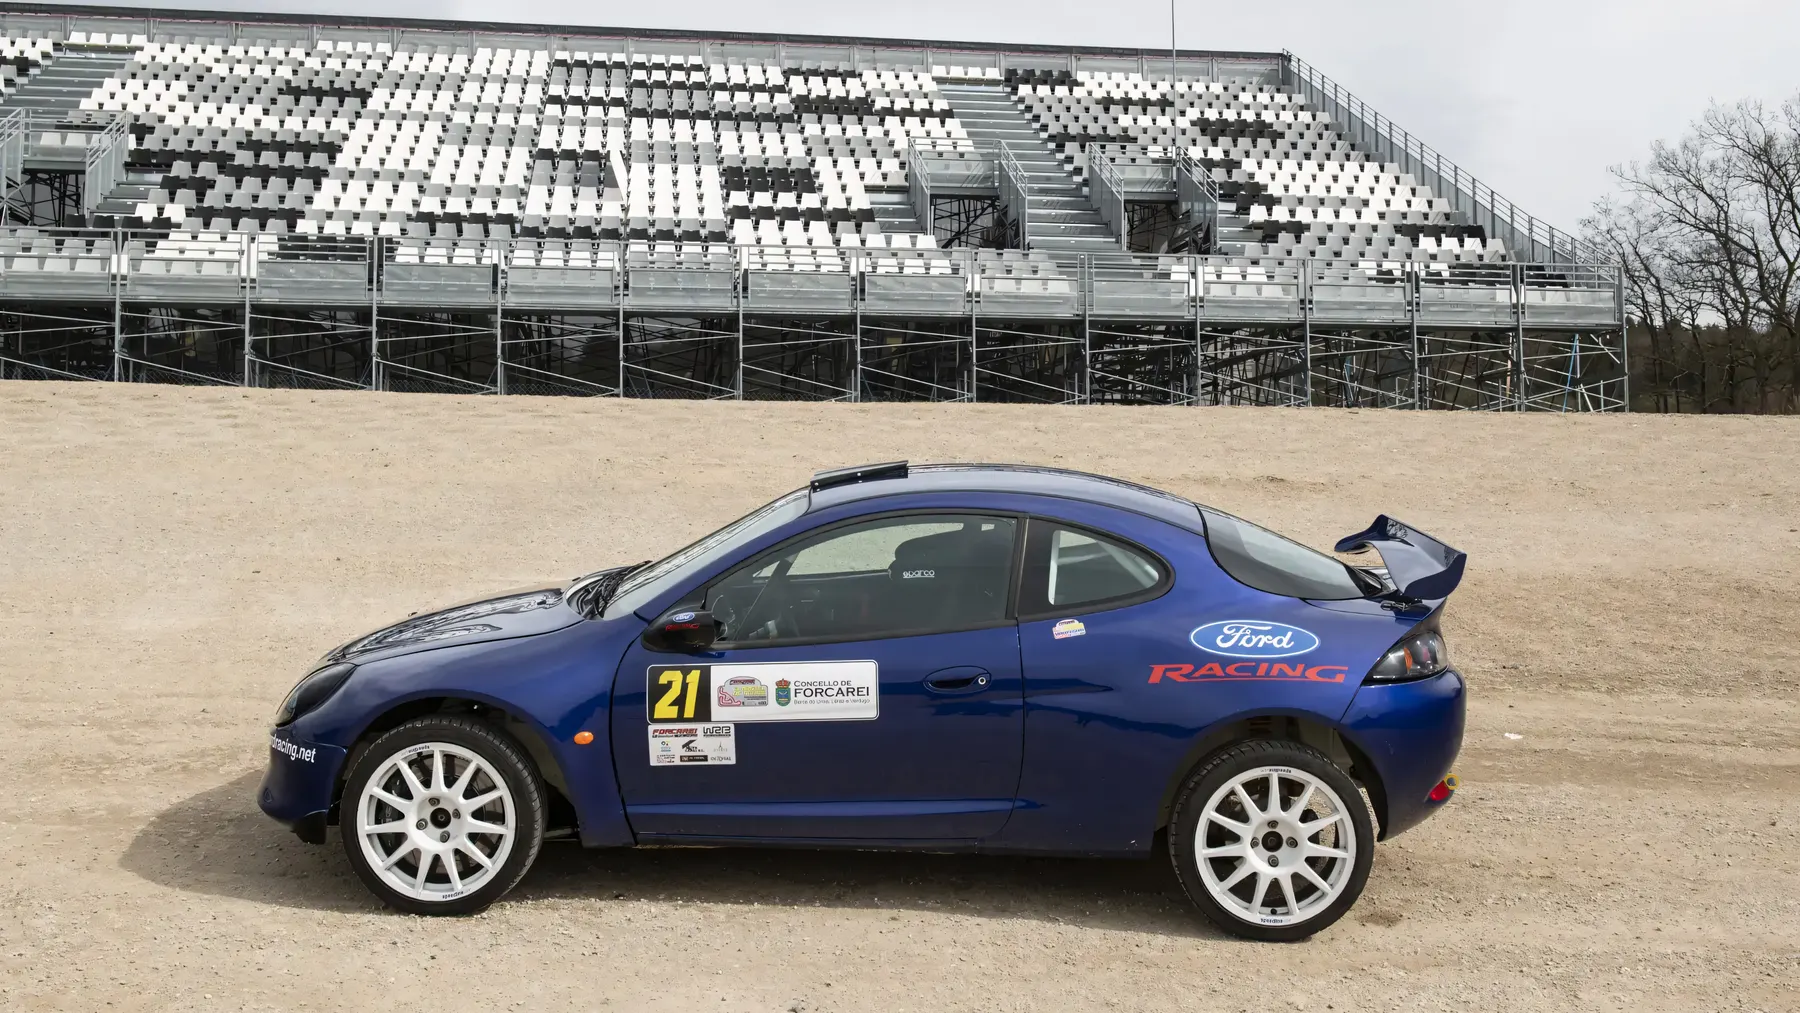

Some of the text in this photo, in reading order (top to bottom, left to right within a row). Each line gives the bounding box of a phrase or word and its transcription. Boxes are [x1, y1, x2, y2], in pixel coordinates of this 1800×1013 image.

[903, 570, 935, 578] sparco
[1216, 625, 1294, 649] Ford
[1148, 662, 1349, 684] RACING
[653, 669, 701, 719] 21
[794, 687, 870, 698] FORCAREI
